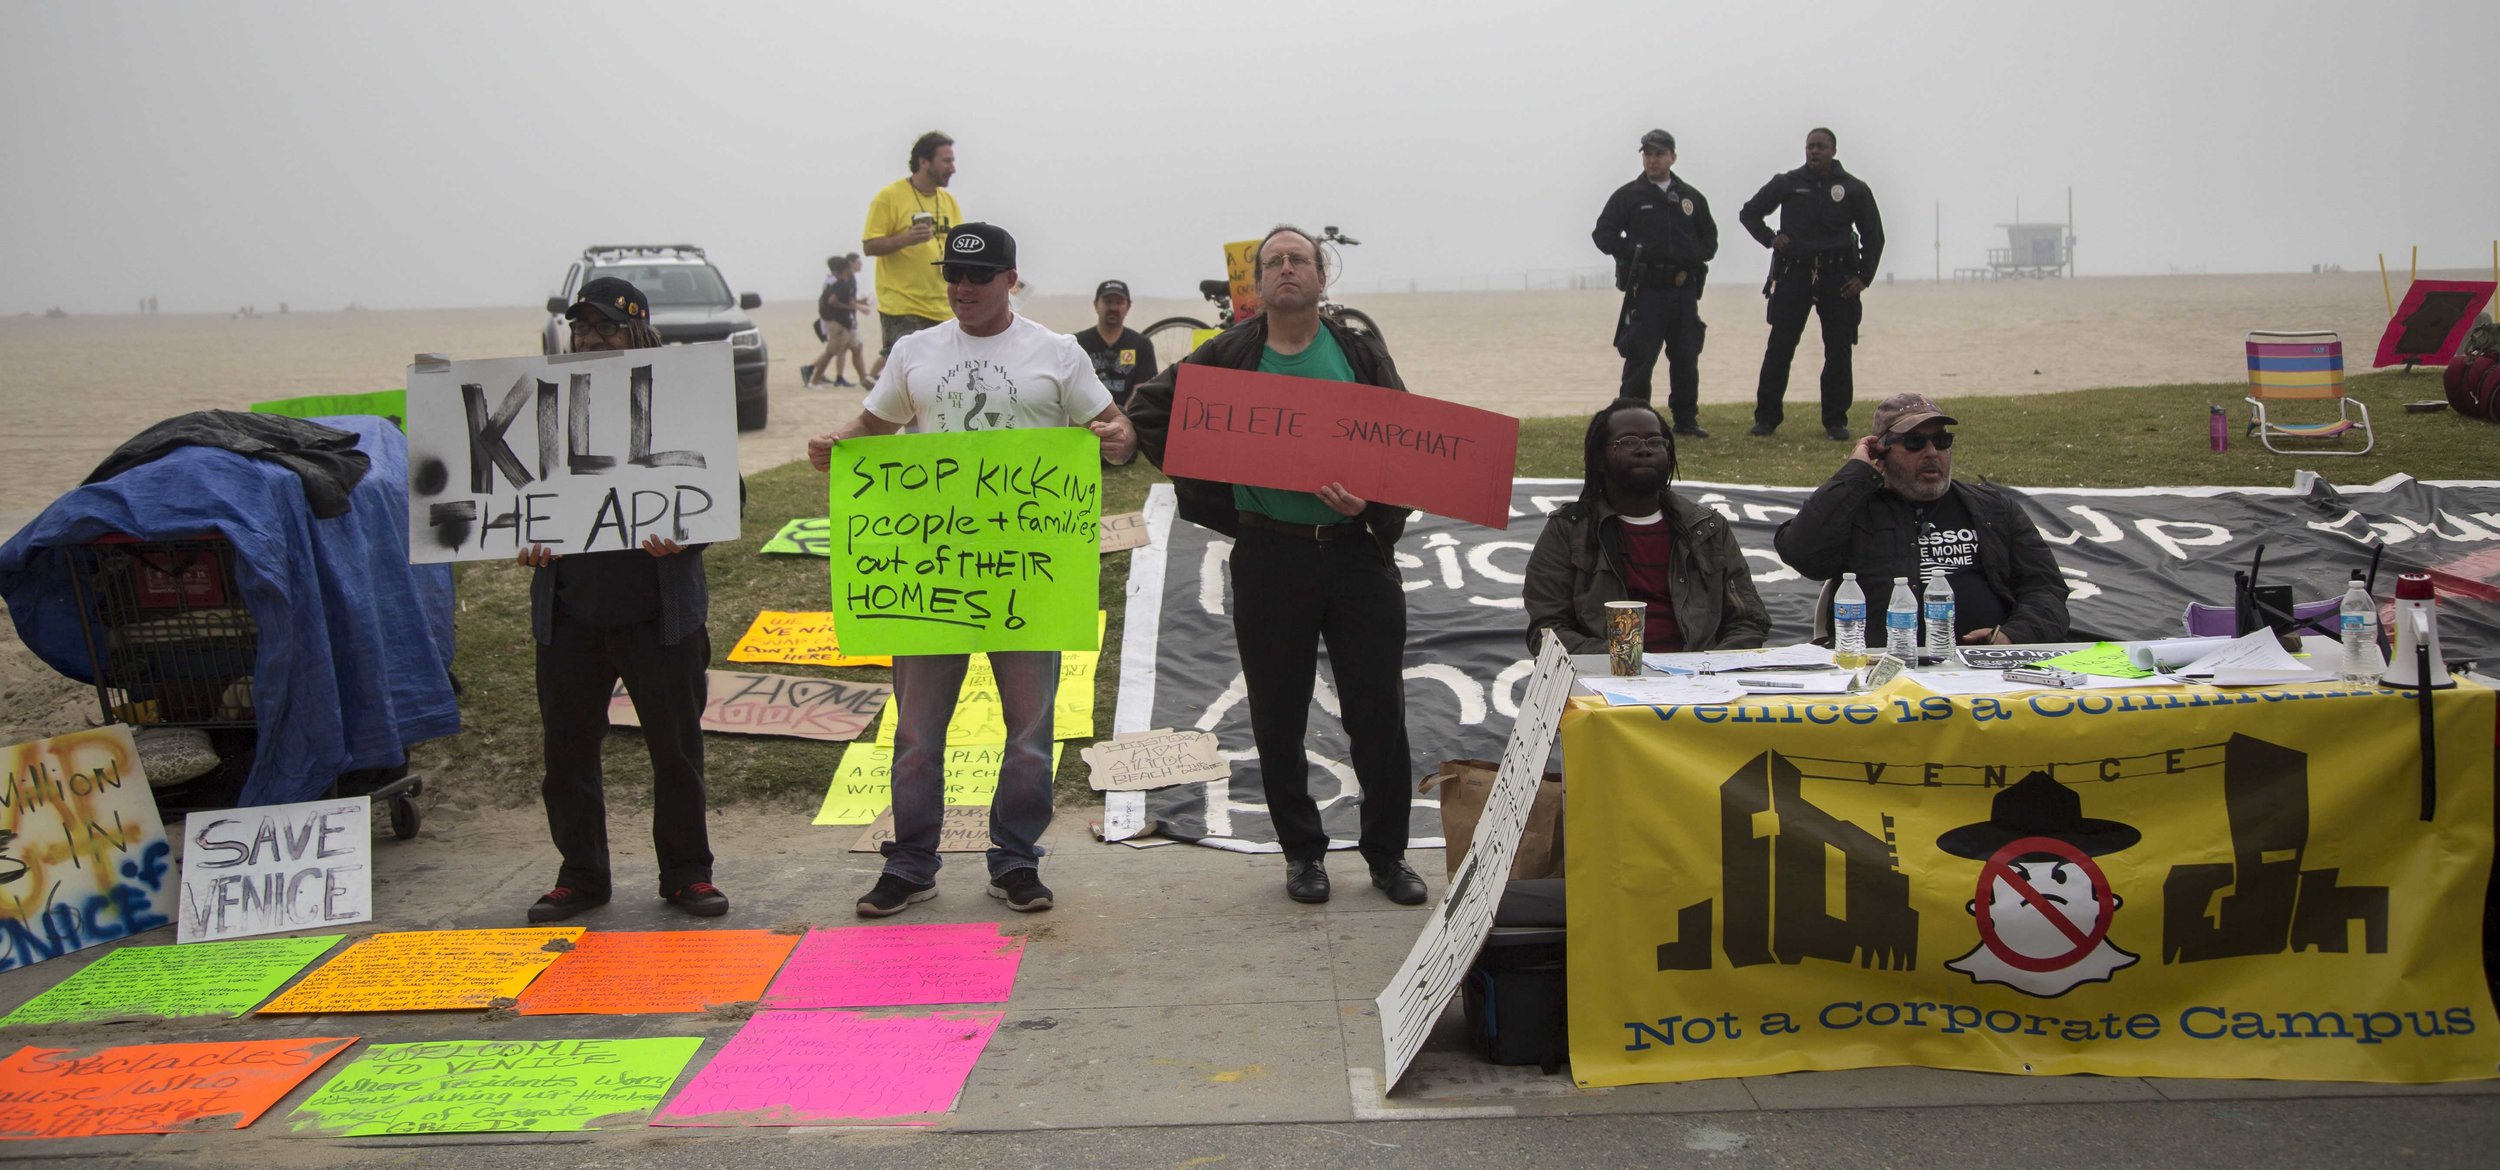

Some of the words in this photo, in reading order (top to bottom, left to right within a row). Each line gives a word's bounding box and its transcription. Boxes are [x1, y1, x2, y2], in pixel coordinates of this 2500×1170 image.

[956, 239, 980, 249] SIP
[461, 364, 706, 496] KILL
[1182, 395, 1306, 438] DELETE
[1331, 417, 1475, 461] SNAPCHAT
[852, 456, 959, 500] STOP
[430, 494, 564, 553] THE
[584, 485, 713, 553] APP
[848, 505, 981, 556] people
[1017, 500, 1098, 544] families
[856, 546, 908, 575] out
[915, 545, 950, 575] of
[958, 548, 1054, 583] THEIR
[1932, 543, 1979, 556] MONEY
[1897, 696, 1953, 723] is
[1972, 697, 2012, 722] a
[850, 767, 862, 777] A
[1112, 766, 1172, 785] BEACH
[196, 805, 361, 868] SAVE
[185, 863, 363, 938] VENICE
[1624, 1011, 1742, 1052] Not
[1760, 1012, 1800, 1036] a
[1819, 1000, 2161, 1043] Corporate
[2179, 1005, 2476, 1045] Campus
[372, 1041, 613, 1062] WELCOME
[373, 1063, 422, 1075] TO
[447, 1053, 621, 1074] VENICE
